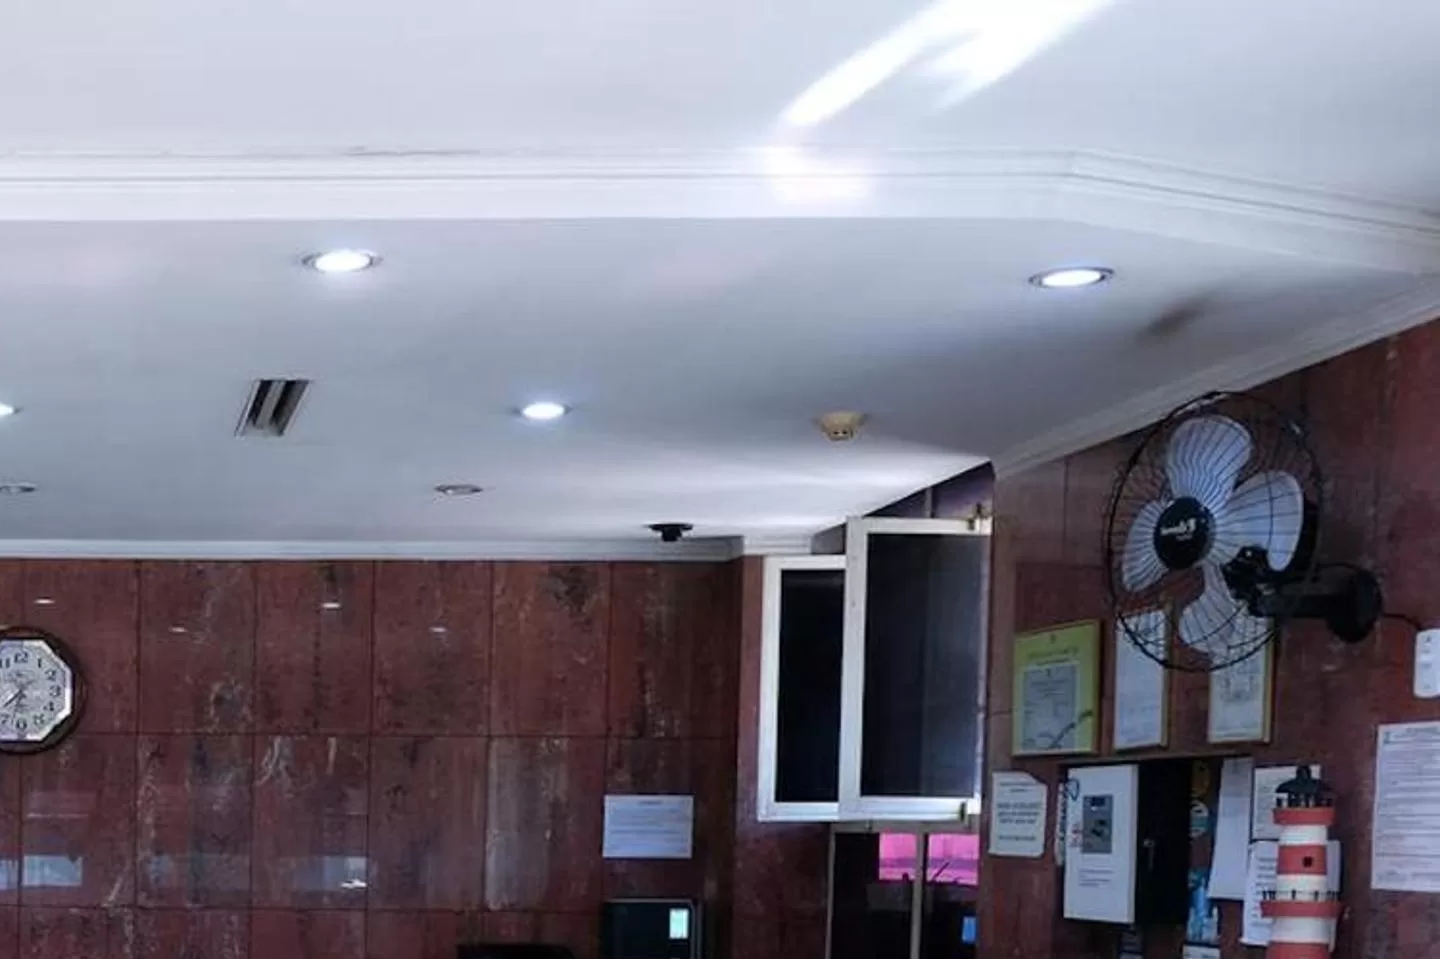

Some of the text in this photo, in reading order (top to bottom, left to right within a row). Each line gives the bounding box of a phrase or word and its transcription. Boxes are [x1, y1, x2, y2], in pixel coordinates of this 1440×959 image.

[0, 658, 10, 669] 11
[14, 651, 28, 664] 12
[45, 669, 56, 681] 2
[49, 685, 61, 697] 3
[43, 701, 54, 712] 4
[1, 713, 10, 725] 7
